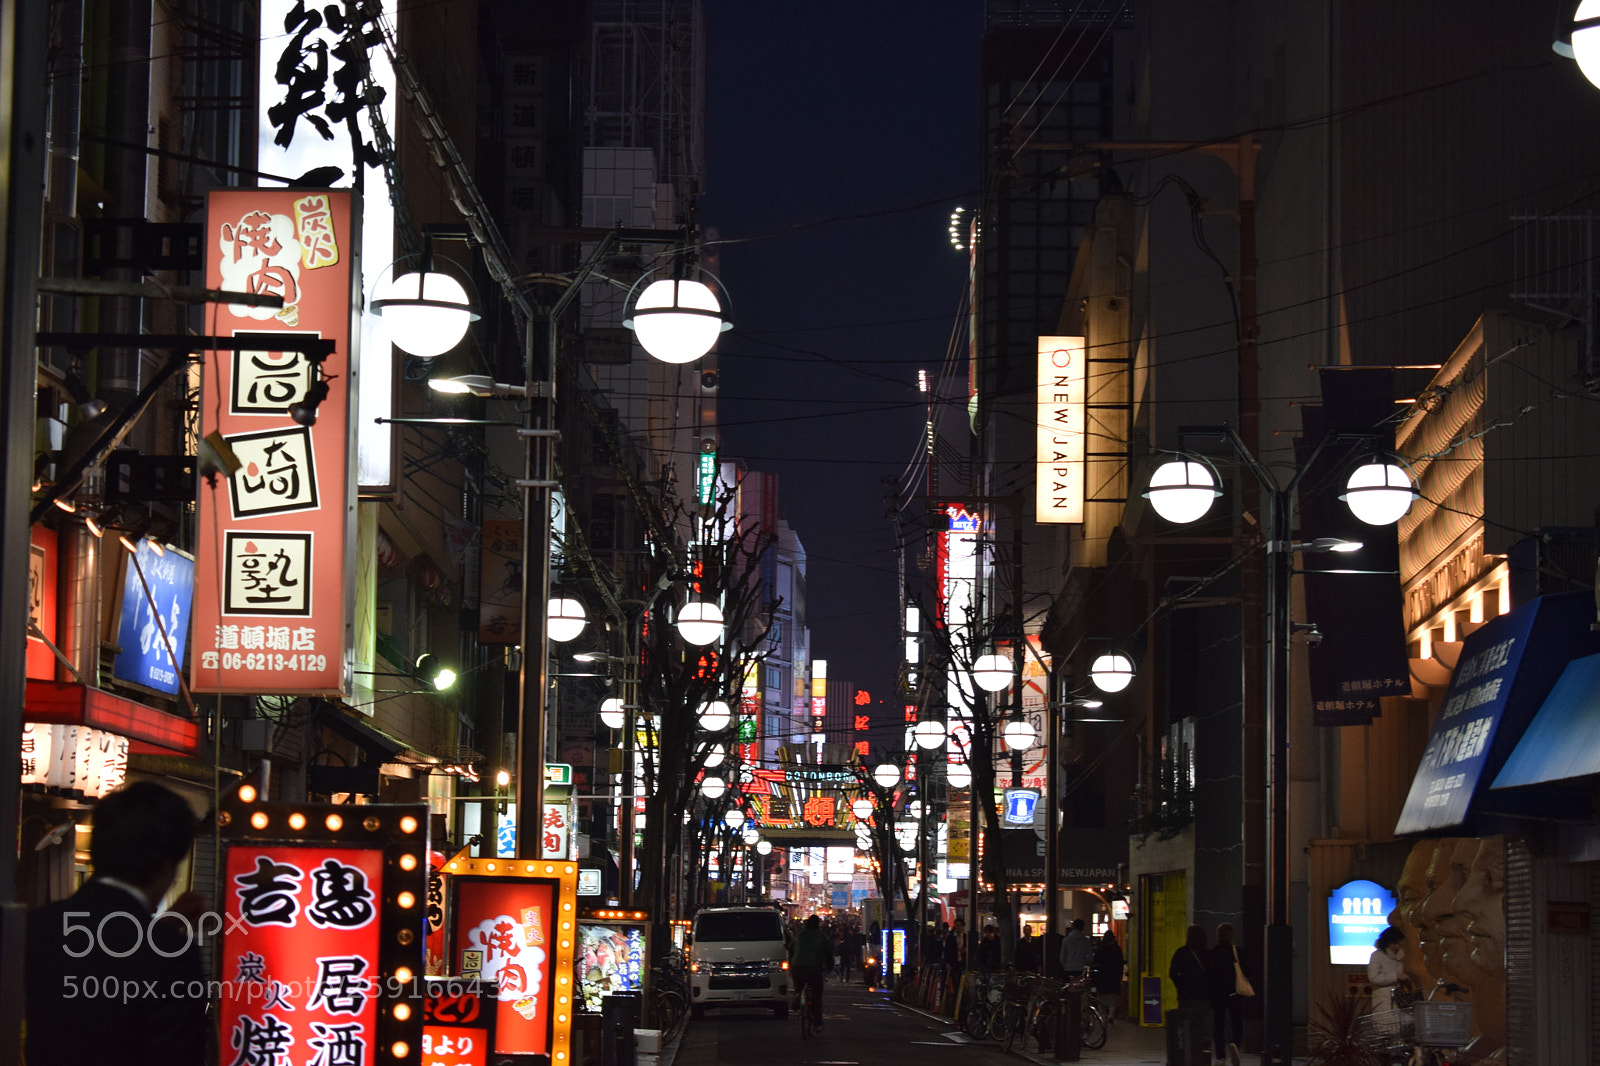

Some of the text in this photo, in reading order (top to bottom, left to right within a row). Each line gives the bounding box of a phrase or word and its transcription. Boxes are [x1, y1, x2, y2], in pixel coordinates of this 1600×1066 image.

[298, 195, 334, 267] 炭火
[221, 211, 299, 306] 焼肉
[1053, 375, 1068, 508] NEW JAPAN
[215, 625, 316, 651] 道頓堀店
[222, 652, 327, 672] 06-6213-4129
[1341, 677, 1406, 692] 道頓堀ホテル
[1316, 700, 1376, 712] 道頓堀ホテル
[785, 771, 855, 783] DOTONBORI
[524, 911, 543, 944] 炭火
[479, 920, 529, 994] 焼肉
[423, 990, 481, 1023] とり
